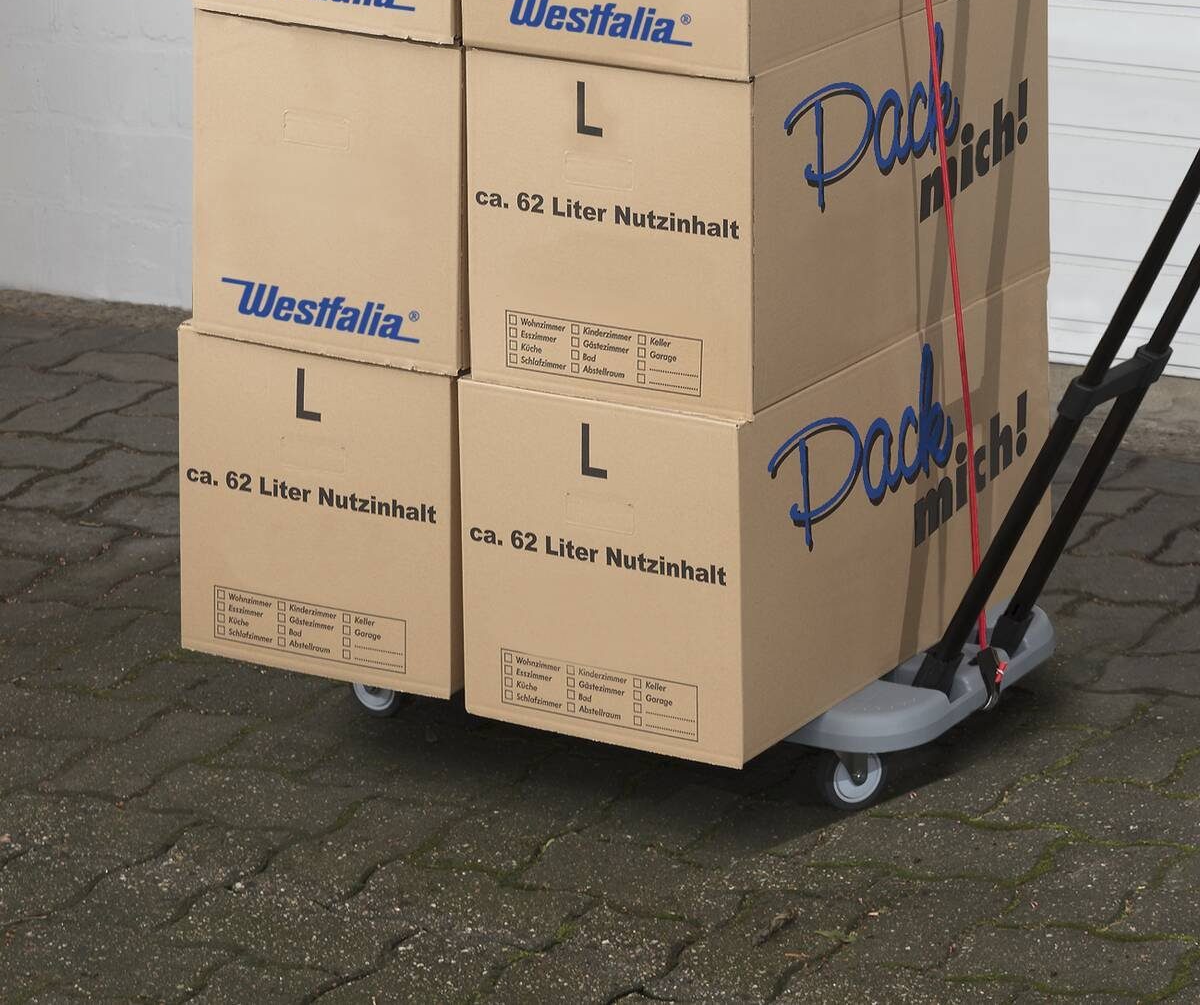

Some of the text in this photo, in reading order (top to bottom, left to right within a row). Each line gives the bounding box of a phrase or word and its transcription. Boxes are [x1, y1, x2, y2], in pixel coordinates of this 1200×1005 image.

[577, 81, 603, 137] L
[784, 21, 960, 213] Pack
[920, 78, 1028, 224] mich!
[475, 191, 740, 240] ca. 62 Liter Nutzinhalt
[520, 318, 565, 332] Wohnzimmer
[520, 330, 557, 343] Esszimmer
[583, 327, 632, 342] Kinderzimmer
[521, 343, 542, 354] Küche
[583, 340, 629, 354] Gästezimmer
[650, 337, 671, 348] Keller
[521, 356, 567, 371] Schlafzimmer
[583, 353, 596, 363] Bad
[650, 351, 677, 363] Garage
[583, 366, 625, 379] Abstellraum
[296, 367, 321, 422] L
[581, 423, 607, 479] L
[767, 343, 953, 553] Pack
[914, 389, 1028, 548] mich!
[186, 467, 437, 524] ca. 62 Liter Nutzinhalt
[469, 527, 727, 586] ca. 62 Liter Nutzinhalt
[228, 593, 272, 608] Wohnzimmer
[228, 604, 263, 618] Esszimmer
[289, 604, 337, 620] Kinderzimmer
[228, 616, 249, 627] Küche
[289, 616, 334, 632] Gästezimmer
[354, 616, 375, 627] Keller
[228, 628, 273, 644] Schlafzimmer
[289, 628, 302, 638] Bad
[354, 628, 382, 641] Garage
[289, 640, 331, 654] Abstellraum
[515, 656, 561, 672] Wohnzimmer
[516, 668, 552, 682] Esszimmer
[578, 668, 627, 685] Kinderzimmer
[516, 680, 538, 692] Küche
[579, 680, 625, 697] Gästezimmer
[645, 681, 667, 692] Keller
[516, 693, 562, 709] Schlafzimmer
[578, 693, 592, 703] Bad
[645, 694, 673, 707] Garage
[579, 705, 621, 721] Abstellraum
